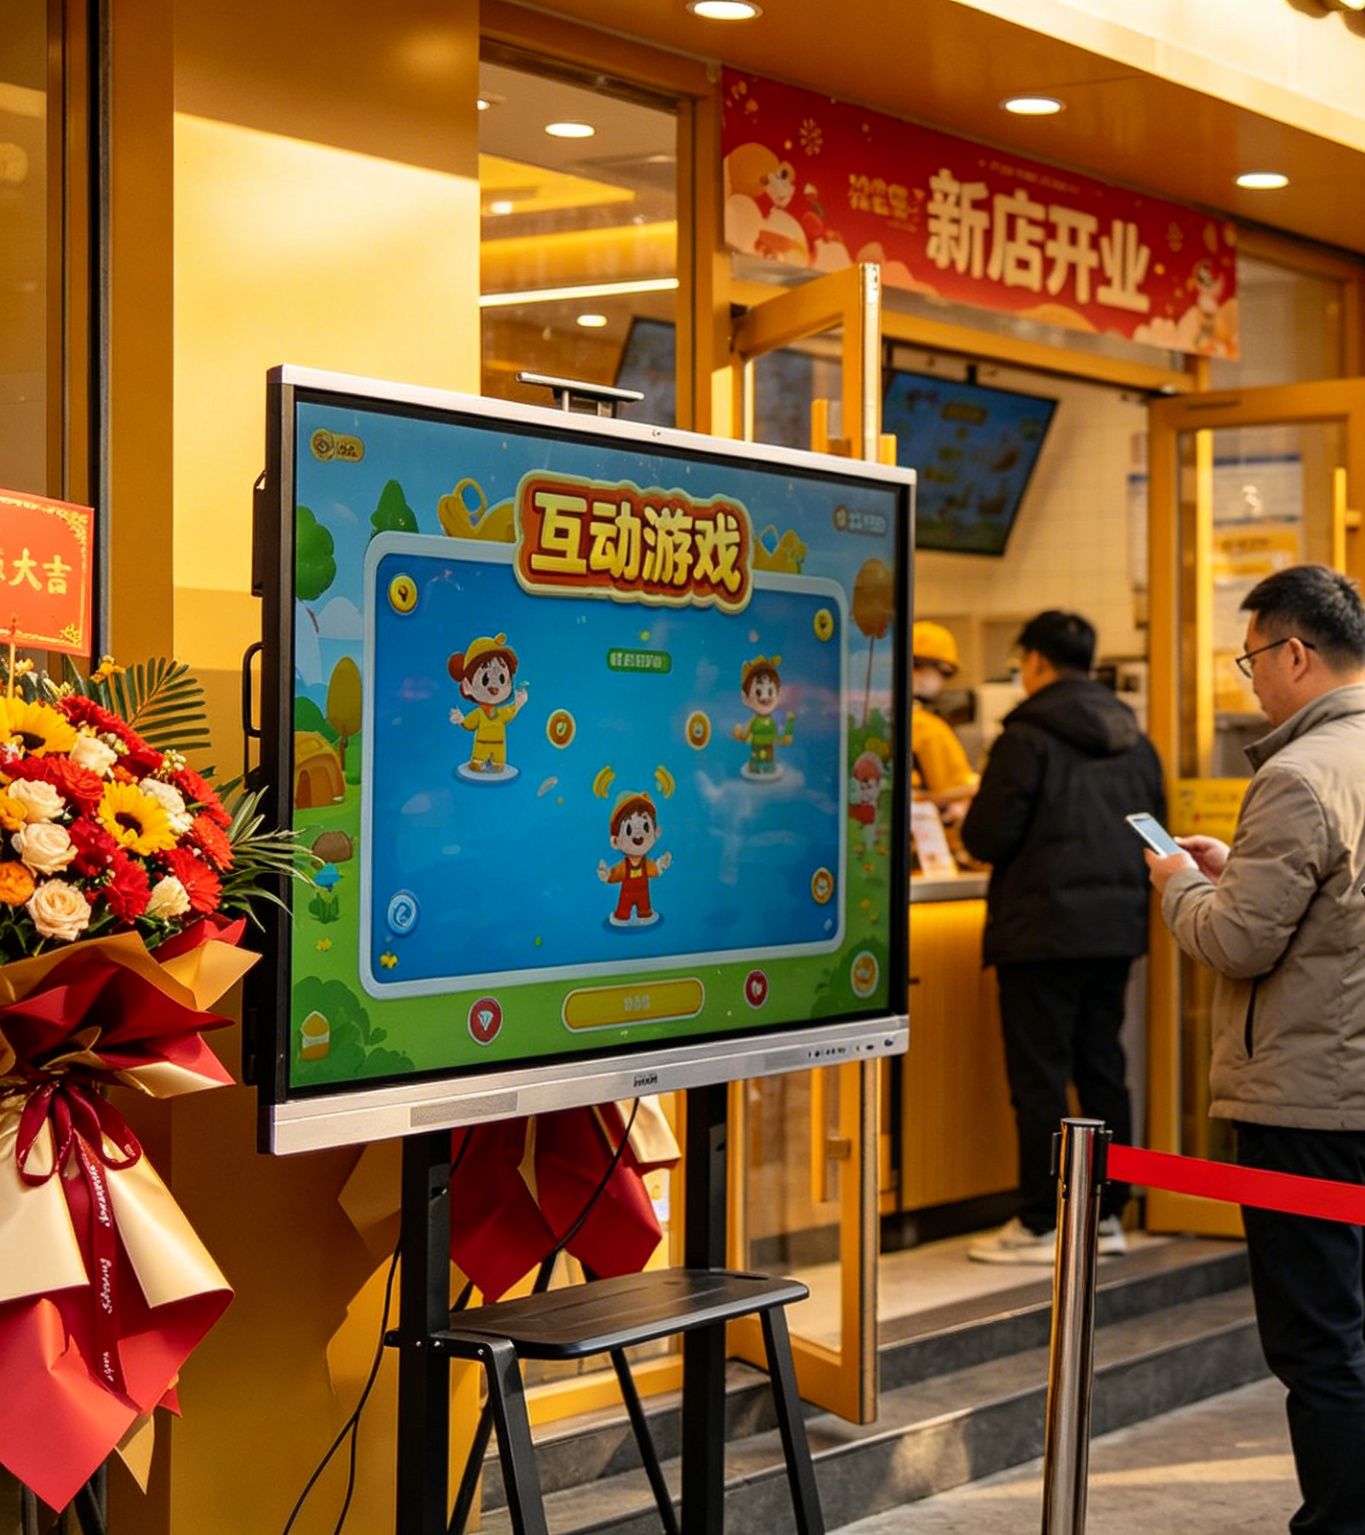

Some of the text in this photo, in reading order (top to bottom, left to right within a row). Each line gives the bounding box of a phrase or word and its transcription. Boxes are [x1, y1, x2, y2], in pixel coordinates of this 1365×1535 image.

[926, 168, 1151, 314] 新店开业
[0, 547, 72, 595] 大吉
[530, 491, 742, 594] 互动游戏
